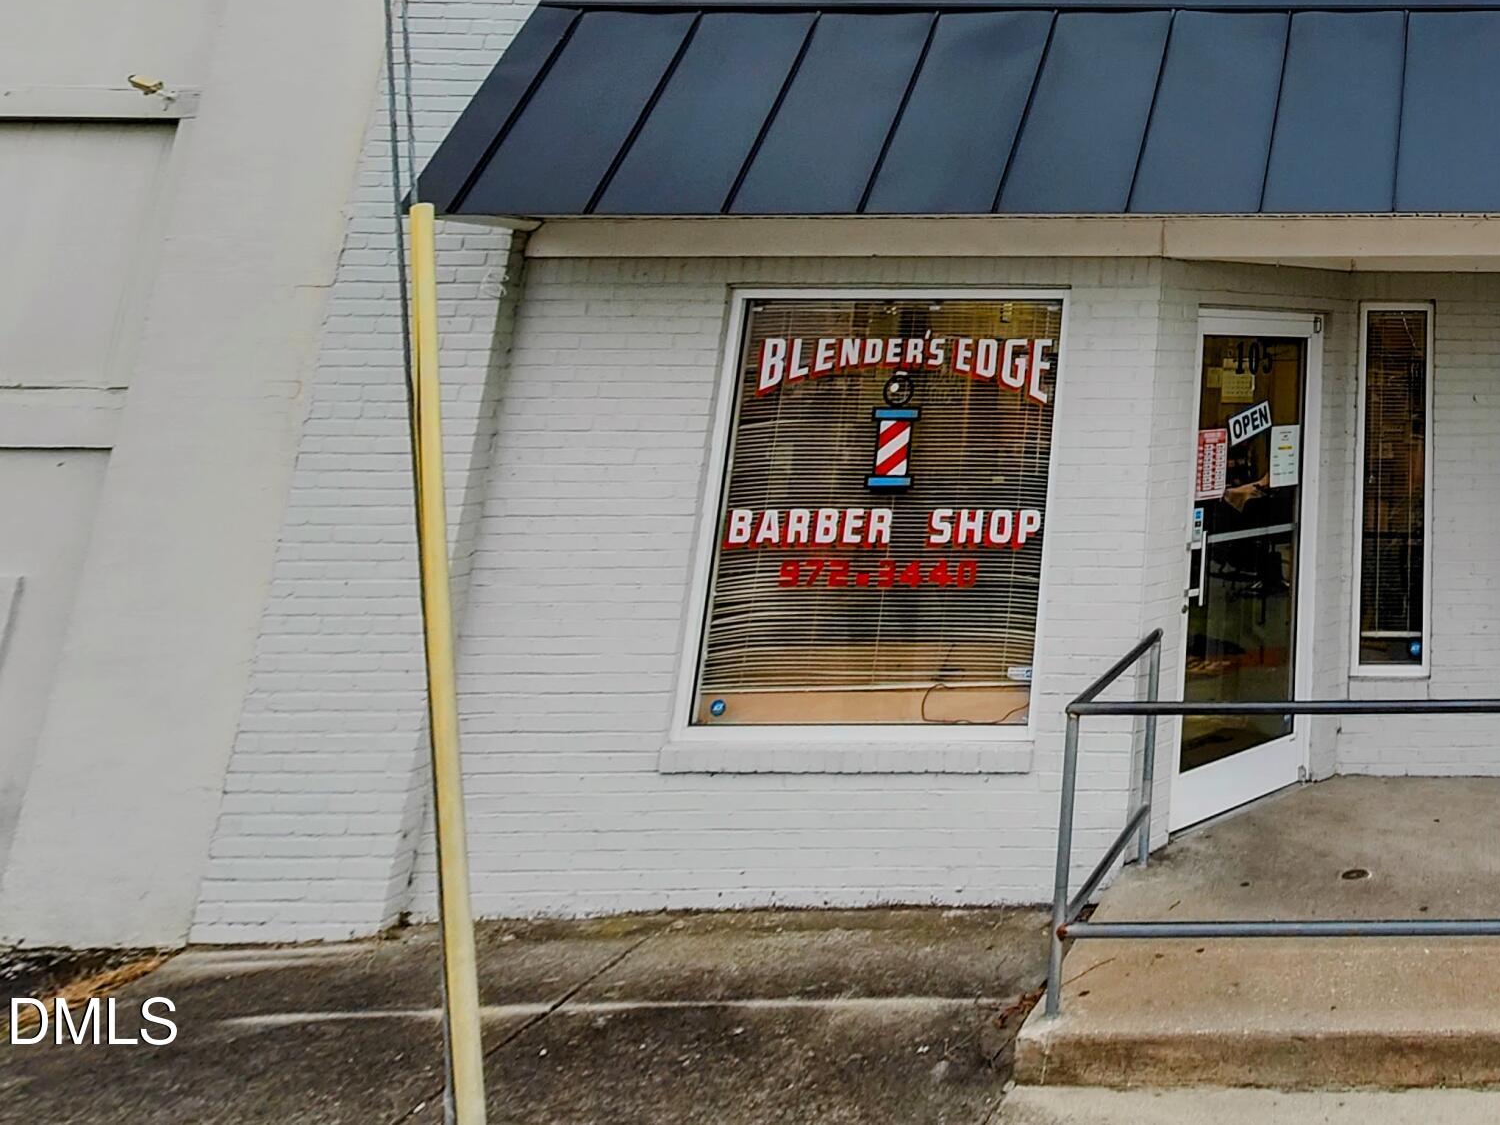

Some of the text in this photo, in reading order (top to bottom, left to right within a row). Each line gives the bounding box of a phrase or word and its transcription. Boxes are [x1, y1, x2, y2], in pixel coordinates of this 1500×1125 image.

[756, 329, 1054, 404] BLENDER'S EDGE
[1234, 341, 1273, 375] 105
[1232, 404, 1269, 440] OPEN
[724, 508, 1041, 549] BARBER SHOP
[778, 559, 978, 589] 972.3440
